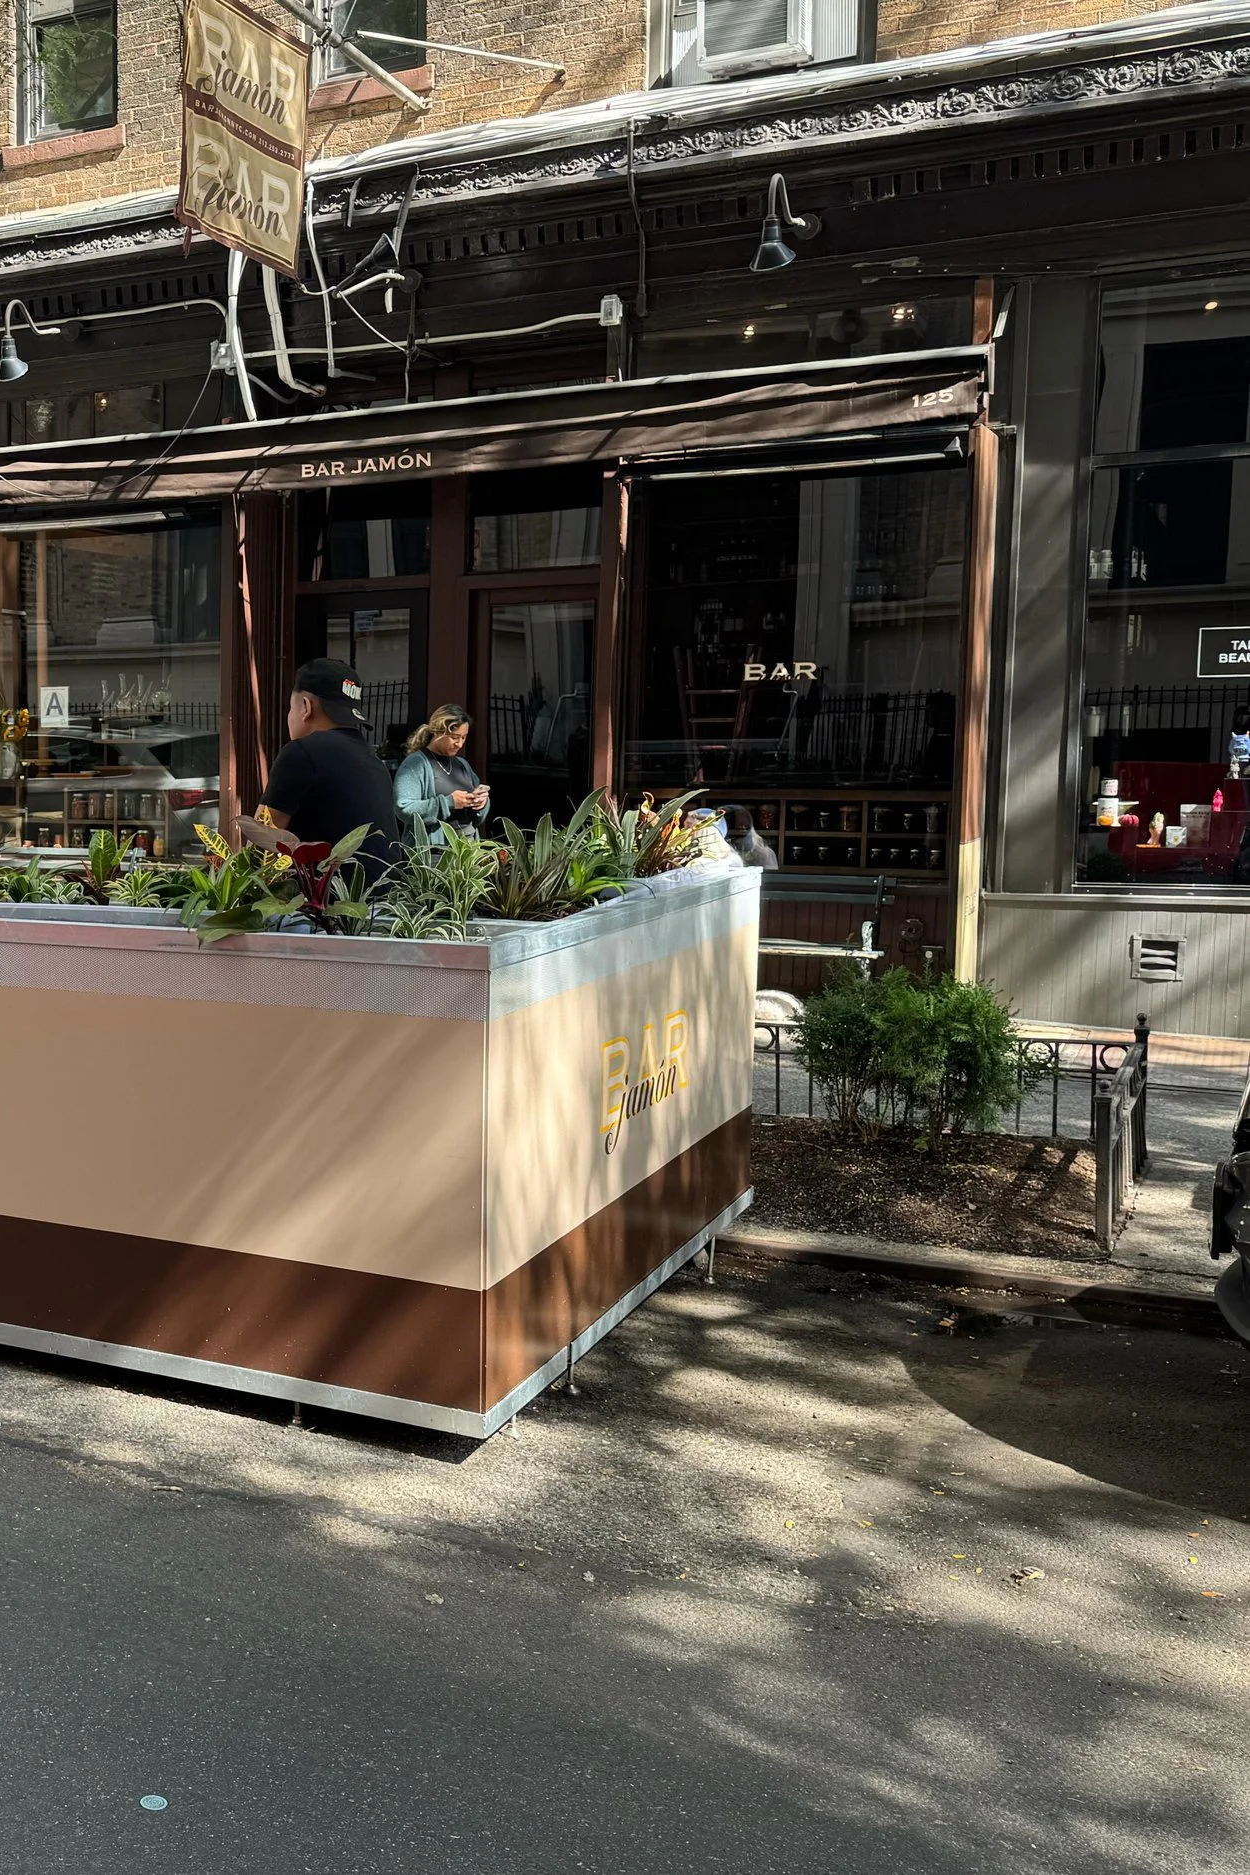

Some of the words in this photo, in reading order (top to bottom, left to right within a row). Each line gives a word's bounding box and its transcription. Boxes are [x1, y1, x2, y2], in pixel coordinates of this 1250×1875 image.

[196, 8, 296, 131] BAR
[196, 50, 287, 125] jamón
[192, 131, 291, 243] BAR
[912, 388, 954, 408] 125
[301, 460, 345, 478] BAR
[350, 448, 432, 474] JAMÓN
[45, 691, 64, 717] A
[743, 661, 817, 682] BAR
[600, 1008, 690, 1134] BAR
[605, 1059, 677, 1156] jamón
